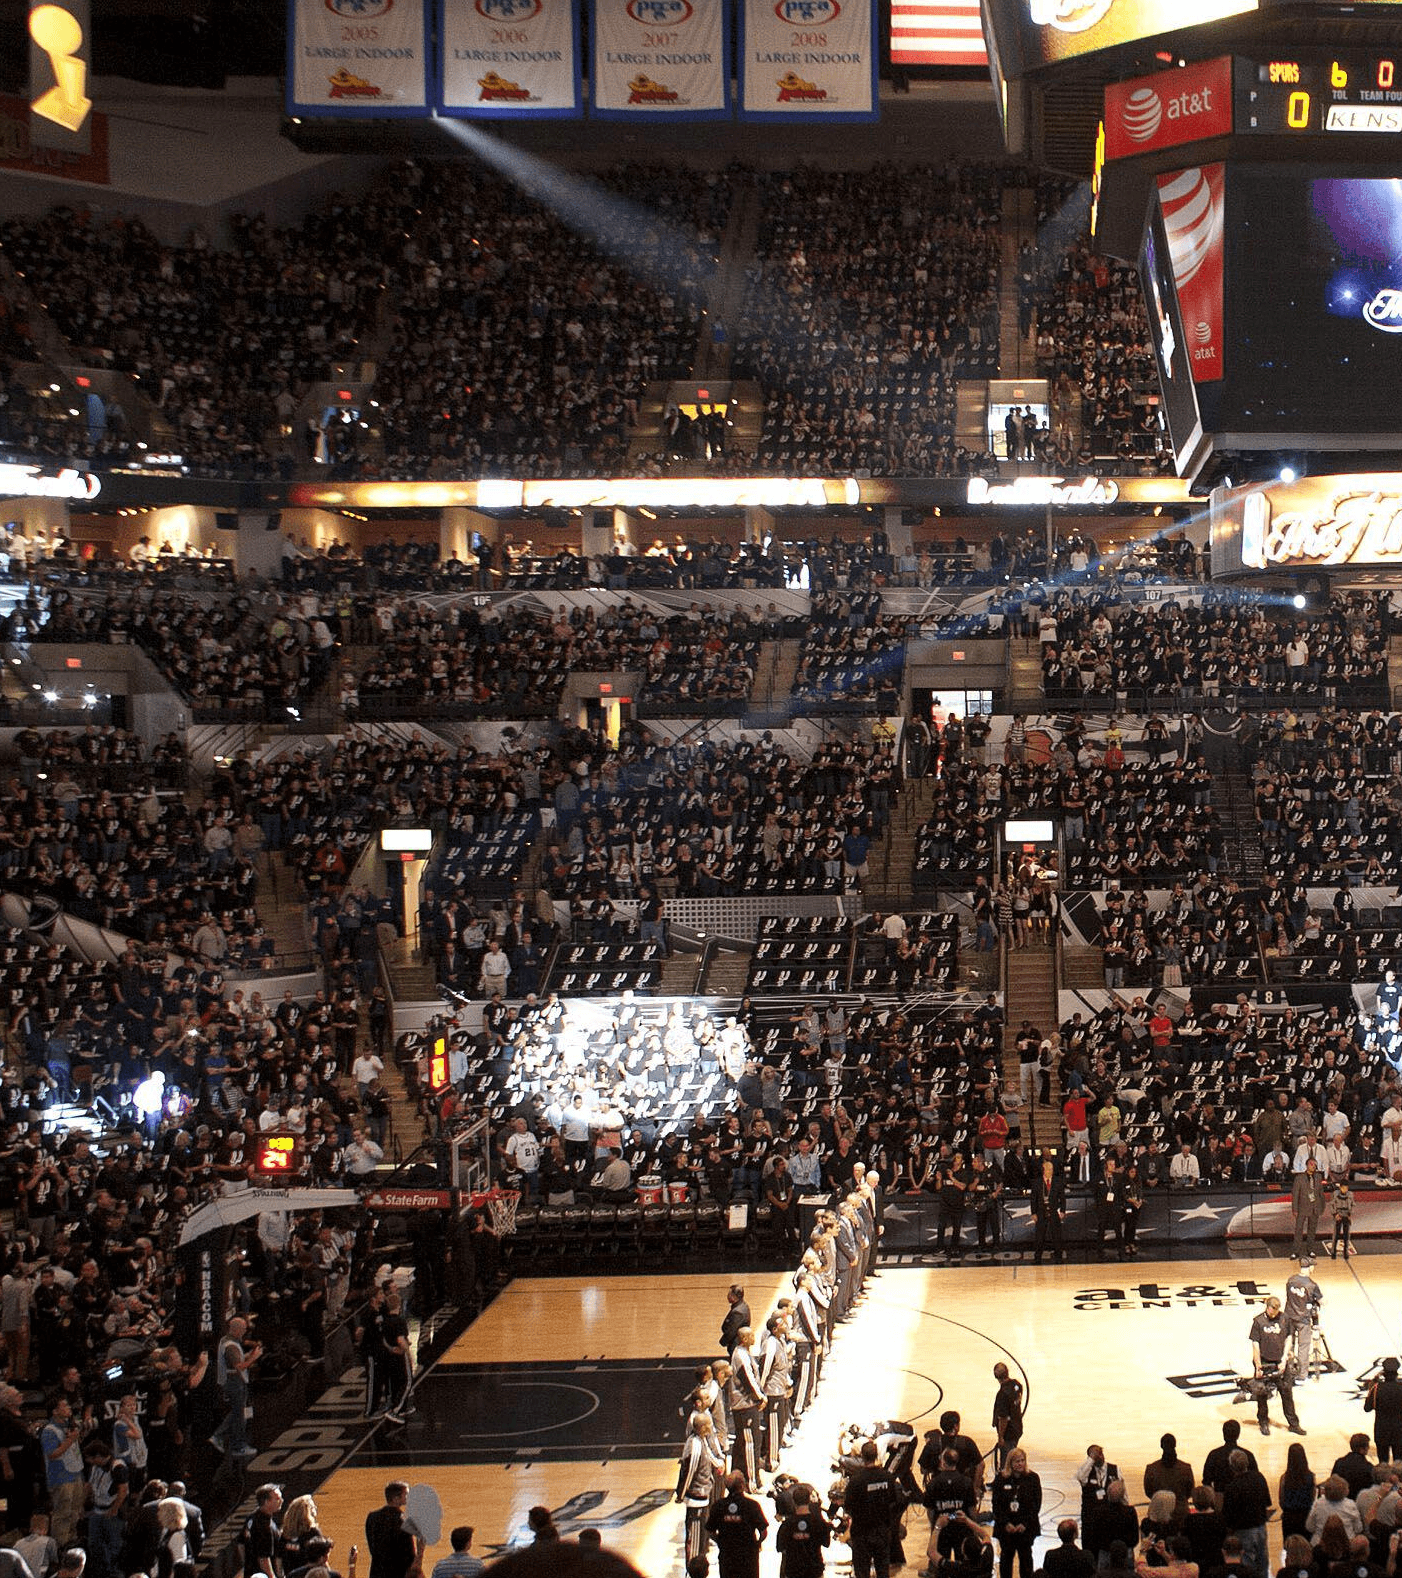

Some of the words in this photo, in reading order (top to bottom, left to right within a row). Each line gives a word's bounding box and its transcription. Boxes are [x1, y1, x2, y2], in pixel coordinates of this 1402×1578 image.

[341, 26, 379, 41] 2005
[491, 30, 529, 44] 2006
[641, 32, 679, 47] 2007
[791, 32, 828, 47] 2008
[304, 46, 352, 59] LARGE
[355, 47, 415, 60] INDOOR
[453, 49, 501, 62] LARGE
[503, 50, 562, 62] INDOOR
[605, 52, 654, 65] LARGE
[655, 53, 713, 65] INDOOR
[755, 52, 801, 64] LARGE
[804, 53, 862, 65] INDOOR
[1268, 61, 1300, 84] SPURS
[1331, 61, 1348, 88] 6
[1377, 60, 1394, 88] 0
[1332, 89, 1348, 100] TOL
[1360, 90, 1383, 101] TEAM
[1167, 87, 1212, 120] at&t
[1287, 91, 1310, 128] 0
[1194, 346, 1216, 360] at&t
[1145, 590, 1161, 600] 107
[1264, 990, 1273, 1003] 8
[263, 1150, 287, 1168] 24
[525, 1147, 536, 1157] 21
[1074, 1280, 1268, 1301] at&t
[1073, 1297, 1268, 1311] CENTER
[866, 1481, 889, 1492] ESPN
